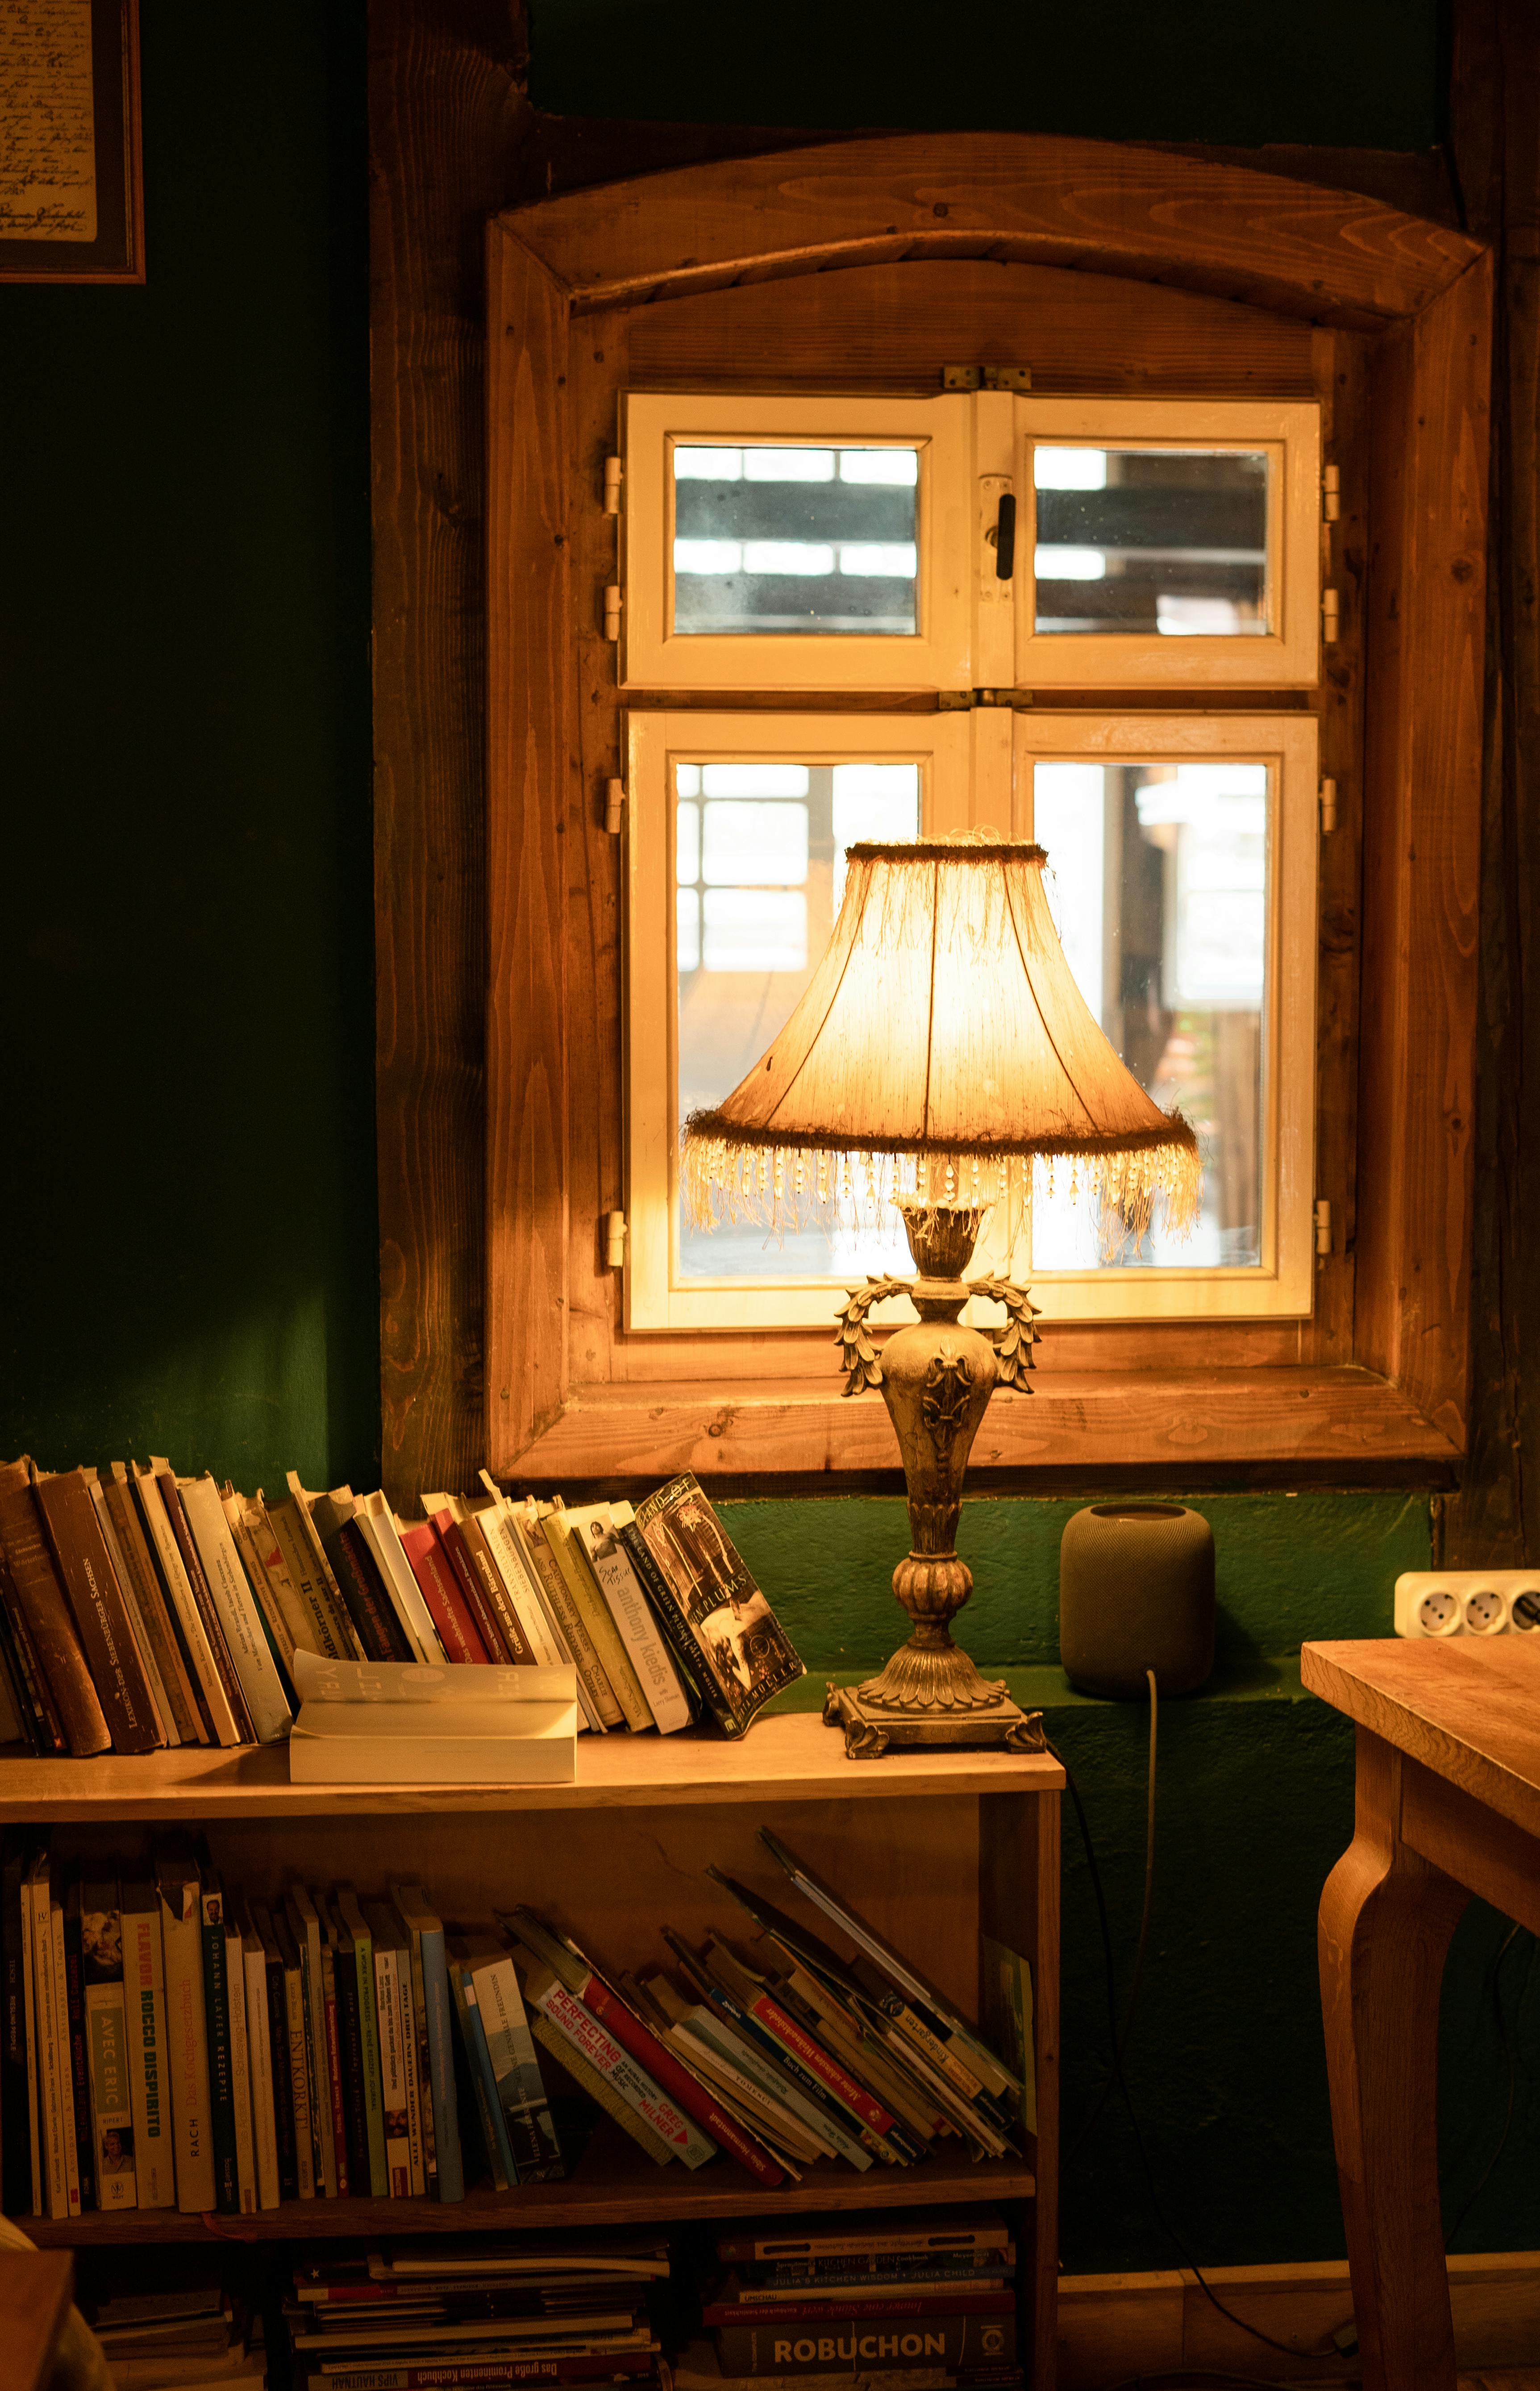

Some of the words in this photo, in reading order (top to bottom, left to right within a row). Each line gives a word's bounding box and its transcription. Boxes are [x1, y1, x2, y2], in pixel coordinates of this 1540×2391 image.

[671, 1477, 691, 1498] OF
[217, 1541, 237, 1584] Siebenbürgen
[250, 1560, 263, 1585] RHYMES
[336, 1530, 370, 1596] Großmächte
[475, 1550, 499, 1593] Bärenland
[498, 1527, 530, 1594] SIEBENBÜRGEN
[79, 1557, 100, 1599] SACHSEN
[300, 1580, 313, 1594] II
[316, 1576, 324, 1585] II
[320, 1586, 331, 1602] aur
[423, 1555, 451, 1607] Sachsenland
[635, 1545, 654, 1570] LAND
[649, 1570, 660, 1583] OF
[655, 1584, 675, 1612] GREEN
[703, 1575, 747, 1612] PLUMS
[233, 1592, 245, 1612] Tieren
[326, 1603, 336, 1614] de
[361, 1596, 377, 1615] der
[492, 1592, 506, 1612] dem
[536, 1556, 547, 1572] AND
[542, 1572, 570, 1621] RUTHLESS
[563, 1622, 587, 1663] RHYMES
[546, 1558, 579, 1618] CAUTIONARY
[572, 1620, 593, 1652] VERSES
[93, 1601, 120, 1666] SIEBENBÜRGER
[240, 1613, 249, 1625] und
[368, 1613, 395, 1655] Fängen
[444, 1606, 467, 1648] wehrhafte
[502, 1611, 513, 1627] aus
[612, 1584, 653, 1645] anthony
[640, 1642, 670, 1686] kiedis
[19, 1631, 27, 1642] und
[195, 1640, 206, 1662] KRONER
[244, 1626, 259, 1657] Menschen
[507, 1626, 524, 1655] Grüße
[461, 1647, 473, 1664] Das
[113, 1667, 125, 1686] DER
[583, 1669, 601, 1699] OTTLEY
[589, 1664, 610, 1696] CHARLIE
[118, 1687, 137, 1729] LEXIKON
[55, 1934, 63, 1967] Tapas
[134, 1923, 155, 1985] FLAVOR
[210, 1935, 222, 1989] JOHANN
[360, 1954, 368, 1974] WORK
[361, 1987, 372, 2022] PROGRESS
[487, 1973, 508, 2017] FREUNDIN
[60, 1986, 69, 2042] Antipasti
[138, 1990, 158, 2047] ROCCO
[181, 1979, 199, 2079] Kochgesetzbuch
[213, 1998, 224, 2037] LAFER
[234, 1983, 247, 2077] Schleswig-Holstein
[549, 1989, 625, 2063] PERFECTING
[99, 2016, 117, 2059] AVEC
[365, 2029, 374, 2047] RENÉ
[498, 2018, 518, 2055] GENIALE
[543, 1999, 576, 2032] SOUND
[569, 2028, 615, 2072] FOREVER
[761, 2006, 818, 2058] Weihnachtslieder
[904, 2011, 950, 2064] Kindergarten
[216, 2045, 228, 2101] REZEPTE
[366, 2049, 376, 2076] REDZEPI
[405, 2042, 414, 2086] DAUERN
[782, 2055, 801, 2074] Buch
[798, 2071, 814, 2086] zum
[811, 2083, 828, 2100] Film
[811, 2053, 844, 2084] schönsten
[102, 2066, 119, 2105] ERIC
[140, 2051, 164, 2137] DISPIRITO
[185, 2083, 196, 2106] Das
[290, 2030, 309, 2130] ENTKORKT!
[368, 2079, 379, 2111] JOURNAL
[609, 2068, 629, 2090] MUSIC
[614, 2064, 625, 2075] OF
[623, 2073, 646, 2099] RECORDED
[621, 2060, 629, 2069] AN
[627, 2067, 642, 2083] AURAL
[639, 2081, 658, 2101] HISTORY
[837, 2079, 862, 2102] Meine
[409, 2090, 417, 2137] WUNDER
[638, 2098, 675, 2138] MILNER
[658, 2102, 684, 2130] GREG
[187, 2118, 201, 2157] RACH
[706, 2112, 753, 2155] Hermannstadt
[748, 2154, 767, 2172] Sibiu
[818, 2257, 855, 2266] KITCHEN
[857, 2254, 894, 2265] GARDEN
[896, 2254, 928, 2262] Cookbook
[773, 2277, 810, 2286] JULIA'S
[814, 2275, 856, 2283] KITCHEN
[859, 2273, 898, 2281] WISDOM
[911, 2270, 940, 2279] JULIA
[944, 2268, 975, 2277] CHILD
[770, 2306, 797, 2315] Kochbuch
[801, 2305, 824, 2316] wert
[827, 2303, 860, 2317] Sünde
[862, 2303, 884, 2313] eine
[887, 2300, 923, 2314] Immer
[774, 2332, 945, 2363] ROBUCHON
[332, 2375, 375, 2389] HAUTNAH
[378, 2373, 398, 2387] VIPS
[417, 2369, 458, 2383] Kochbuch
[460, 2365, 512, 2381] Prominenten
[515, 2362, 539, 2378] große
[541, 2363, 557, 2376] Das
